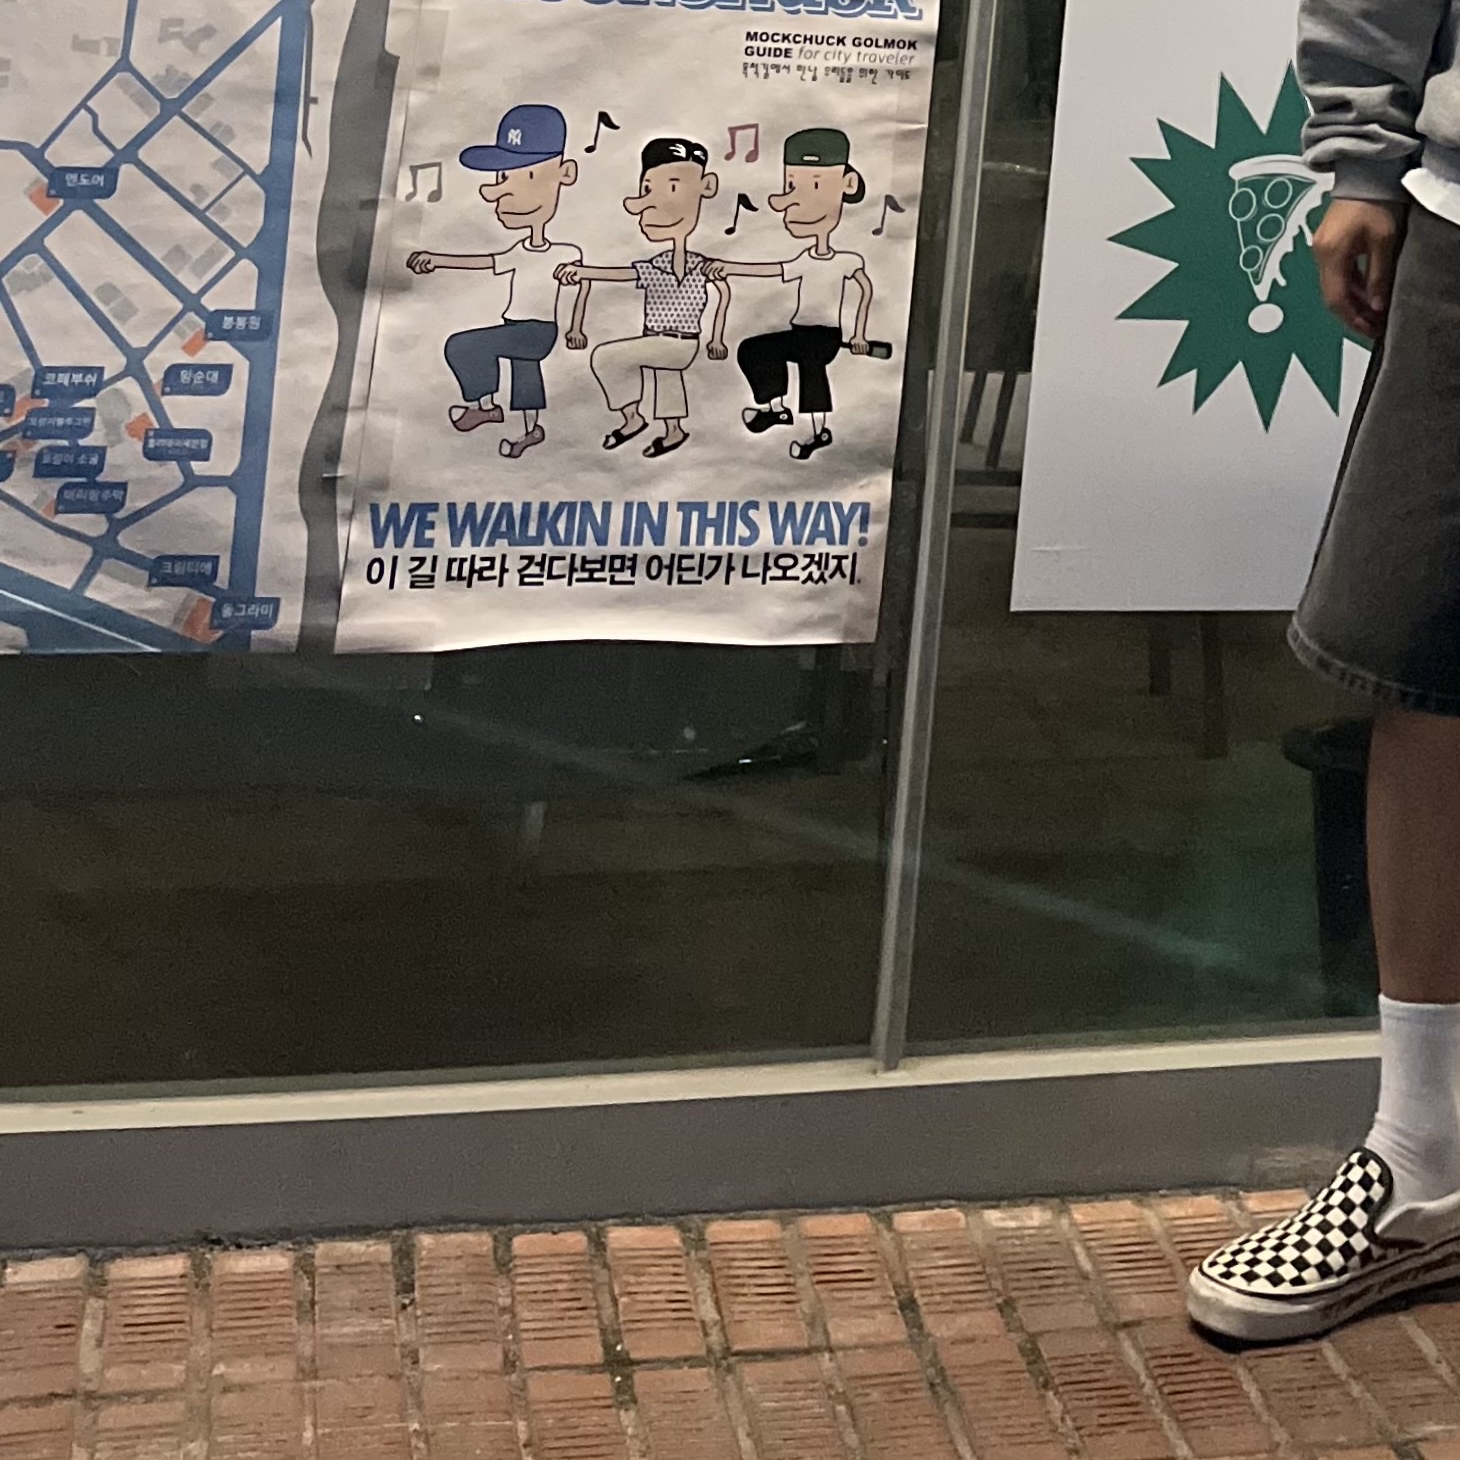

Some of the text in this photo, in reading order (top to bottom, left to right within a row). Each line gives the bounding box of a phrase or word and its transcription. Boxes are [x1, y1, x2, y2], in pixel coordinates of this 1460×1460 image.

[745, 30, 918, 51] MOCKCHUCK GOLMOK
[744, 45, 916, 67] GUIDE for city traveler
[369, 500, 871, 549] WE WALKIN IN THIS WAY!
[365, 551, 863, 590] 이 길 따라 걷다보면 어딘가 나오겠지.
